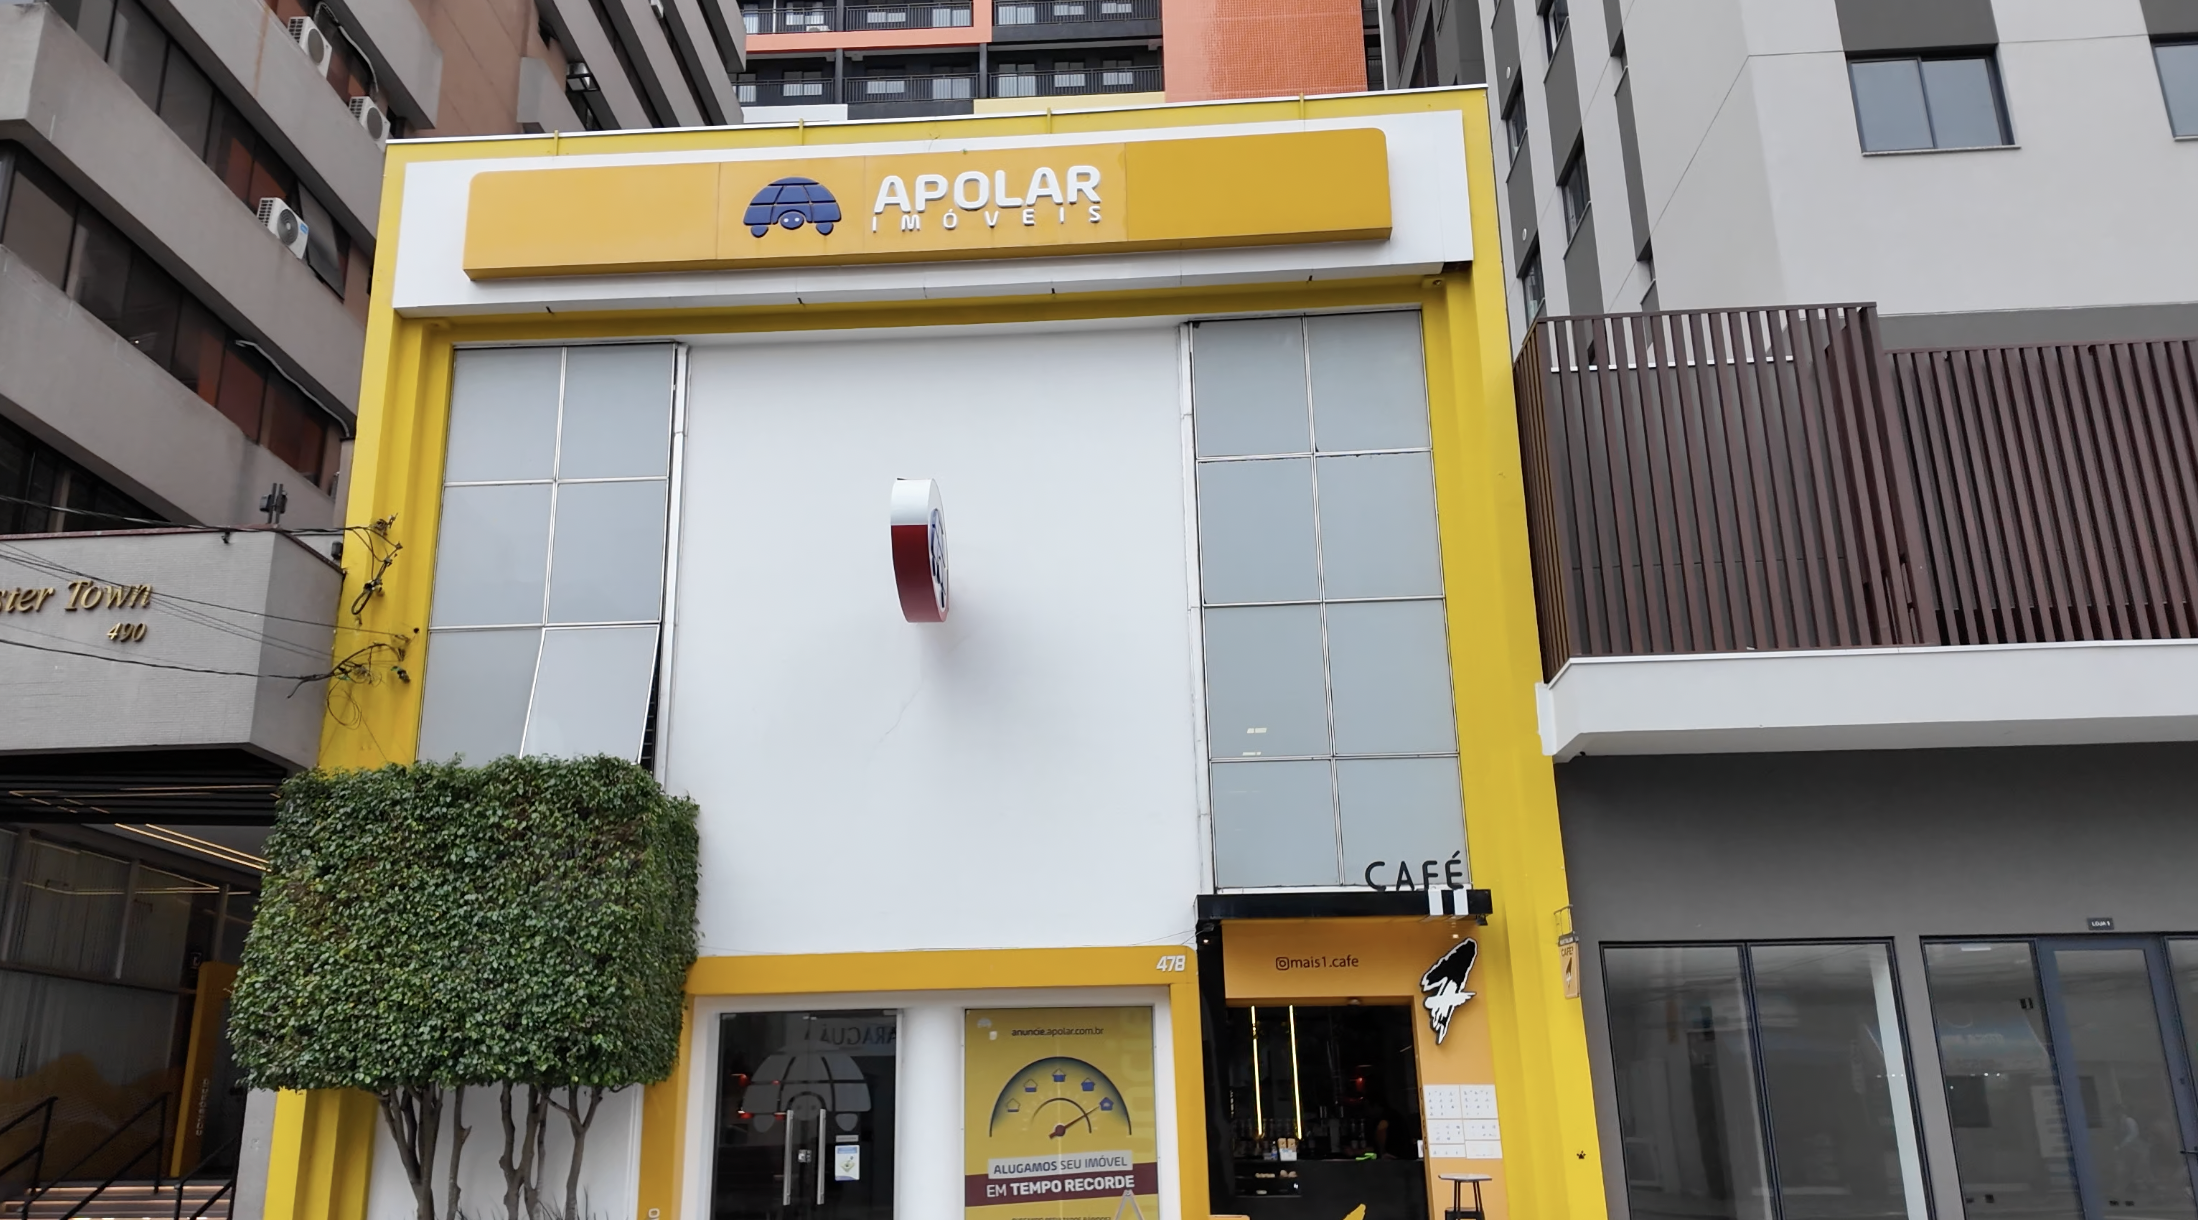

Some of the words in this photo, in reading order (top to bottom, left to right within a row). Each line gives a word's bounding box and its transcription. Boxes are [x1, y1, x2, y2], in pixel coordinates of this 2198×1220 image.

[873, 165, 1102, 214] APOLAR
[872, 206, 1102, 232] IMÓVEIS
[65, 579, 153, 611] Town
[106, 622, 148, 642] 490
[1365, 850, 1464, 891] CAFÉ
[1156, 955, 1186, 972] 478
[1011, 1026, 1104, 1037] anuncie.apolar.com.br
[993, 1161, 1058, 1175] ALUGAMOS
[1060, 1159, 1082, 1171] SEU
[1085, 1155, 1128, 1168] IMÓVEL
[986, 1184, 1007, 1198] EM
[1010, 1180, 1062, 1196] TEMPO
[1064, 1175, 1135, 1192] RECORDE
